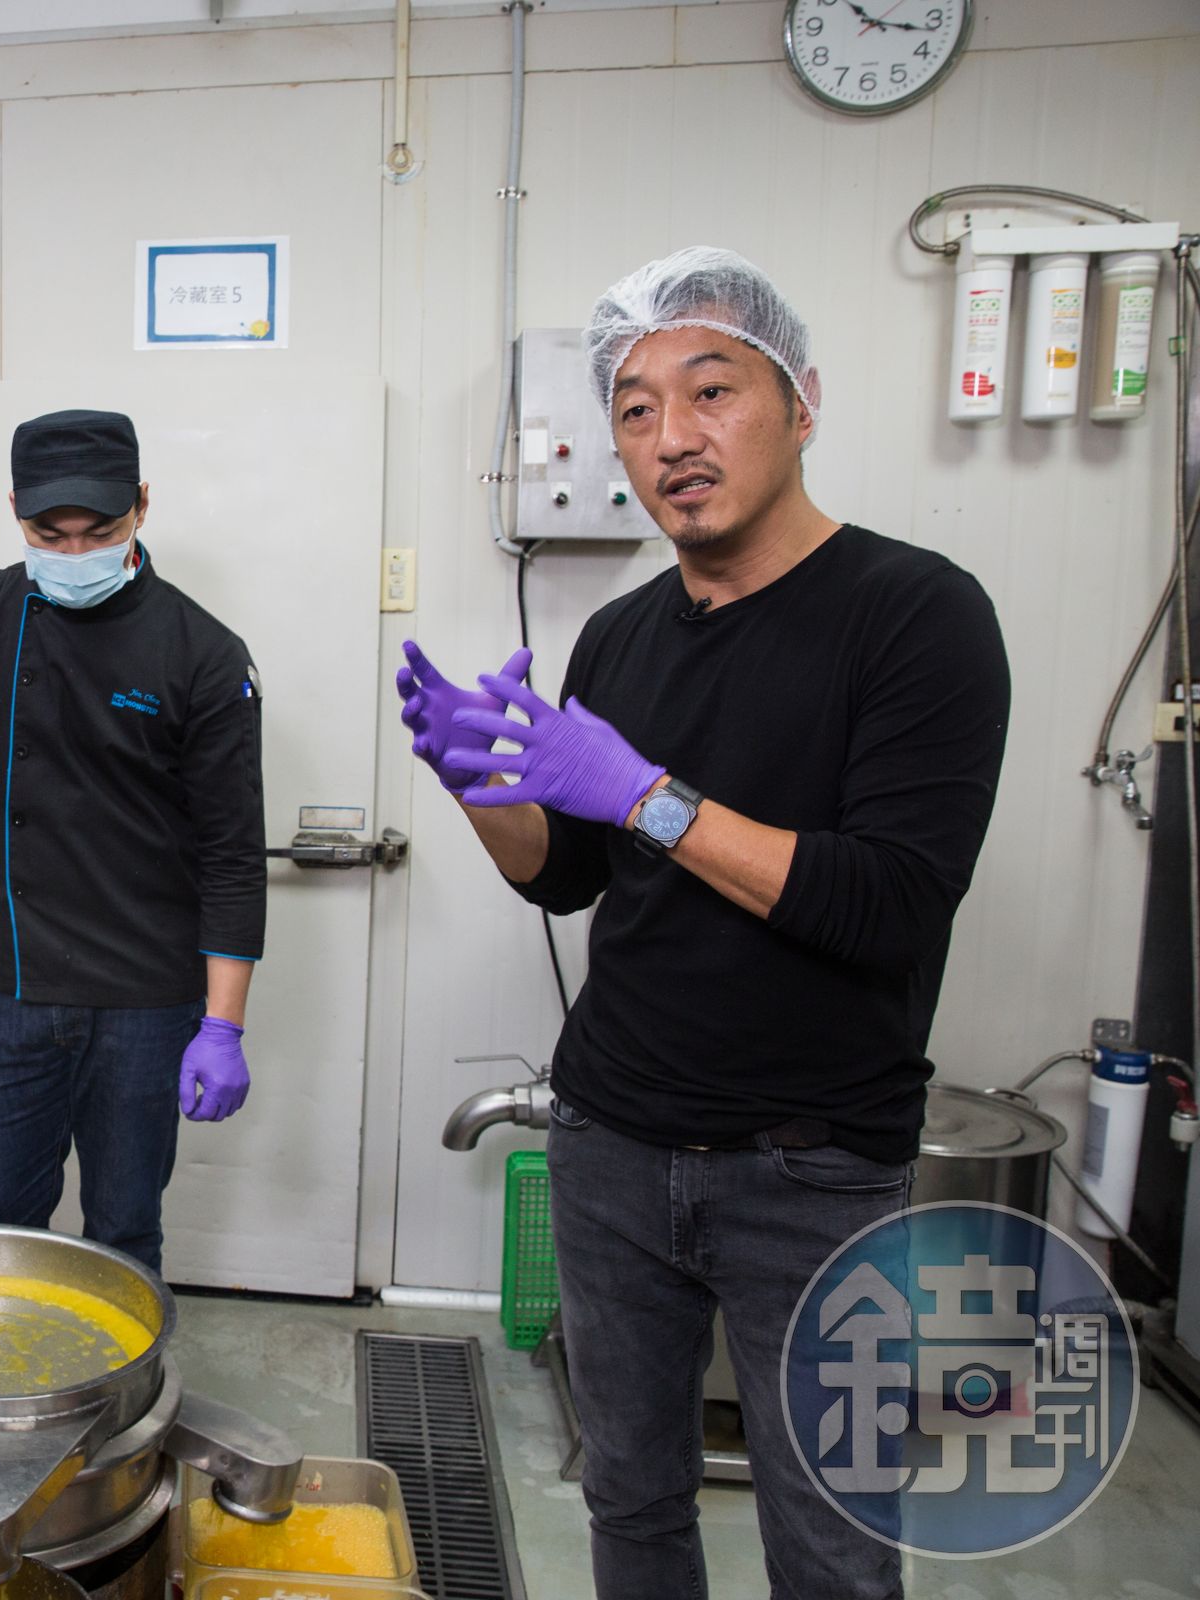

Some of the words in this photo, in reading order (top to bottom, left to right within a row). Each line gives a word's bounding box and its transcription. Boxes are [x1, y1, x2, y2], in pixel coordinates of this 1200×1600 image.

[806, 17, 823, 37] 9
[925, 9, 943, 30] 3
[812, 46, 829, 66] 8
[913, 40, 930, 60] 4
[834, 67, 850, 87] 7
[859, 72, 877, 92] 6
[890, 63, 907, 84] 5
